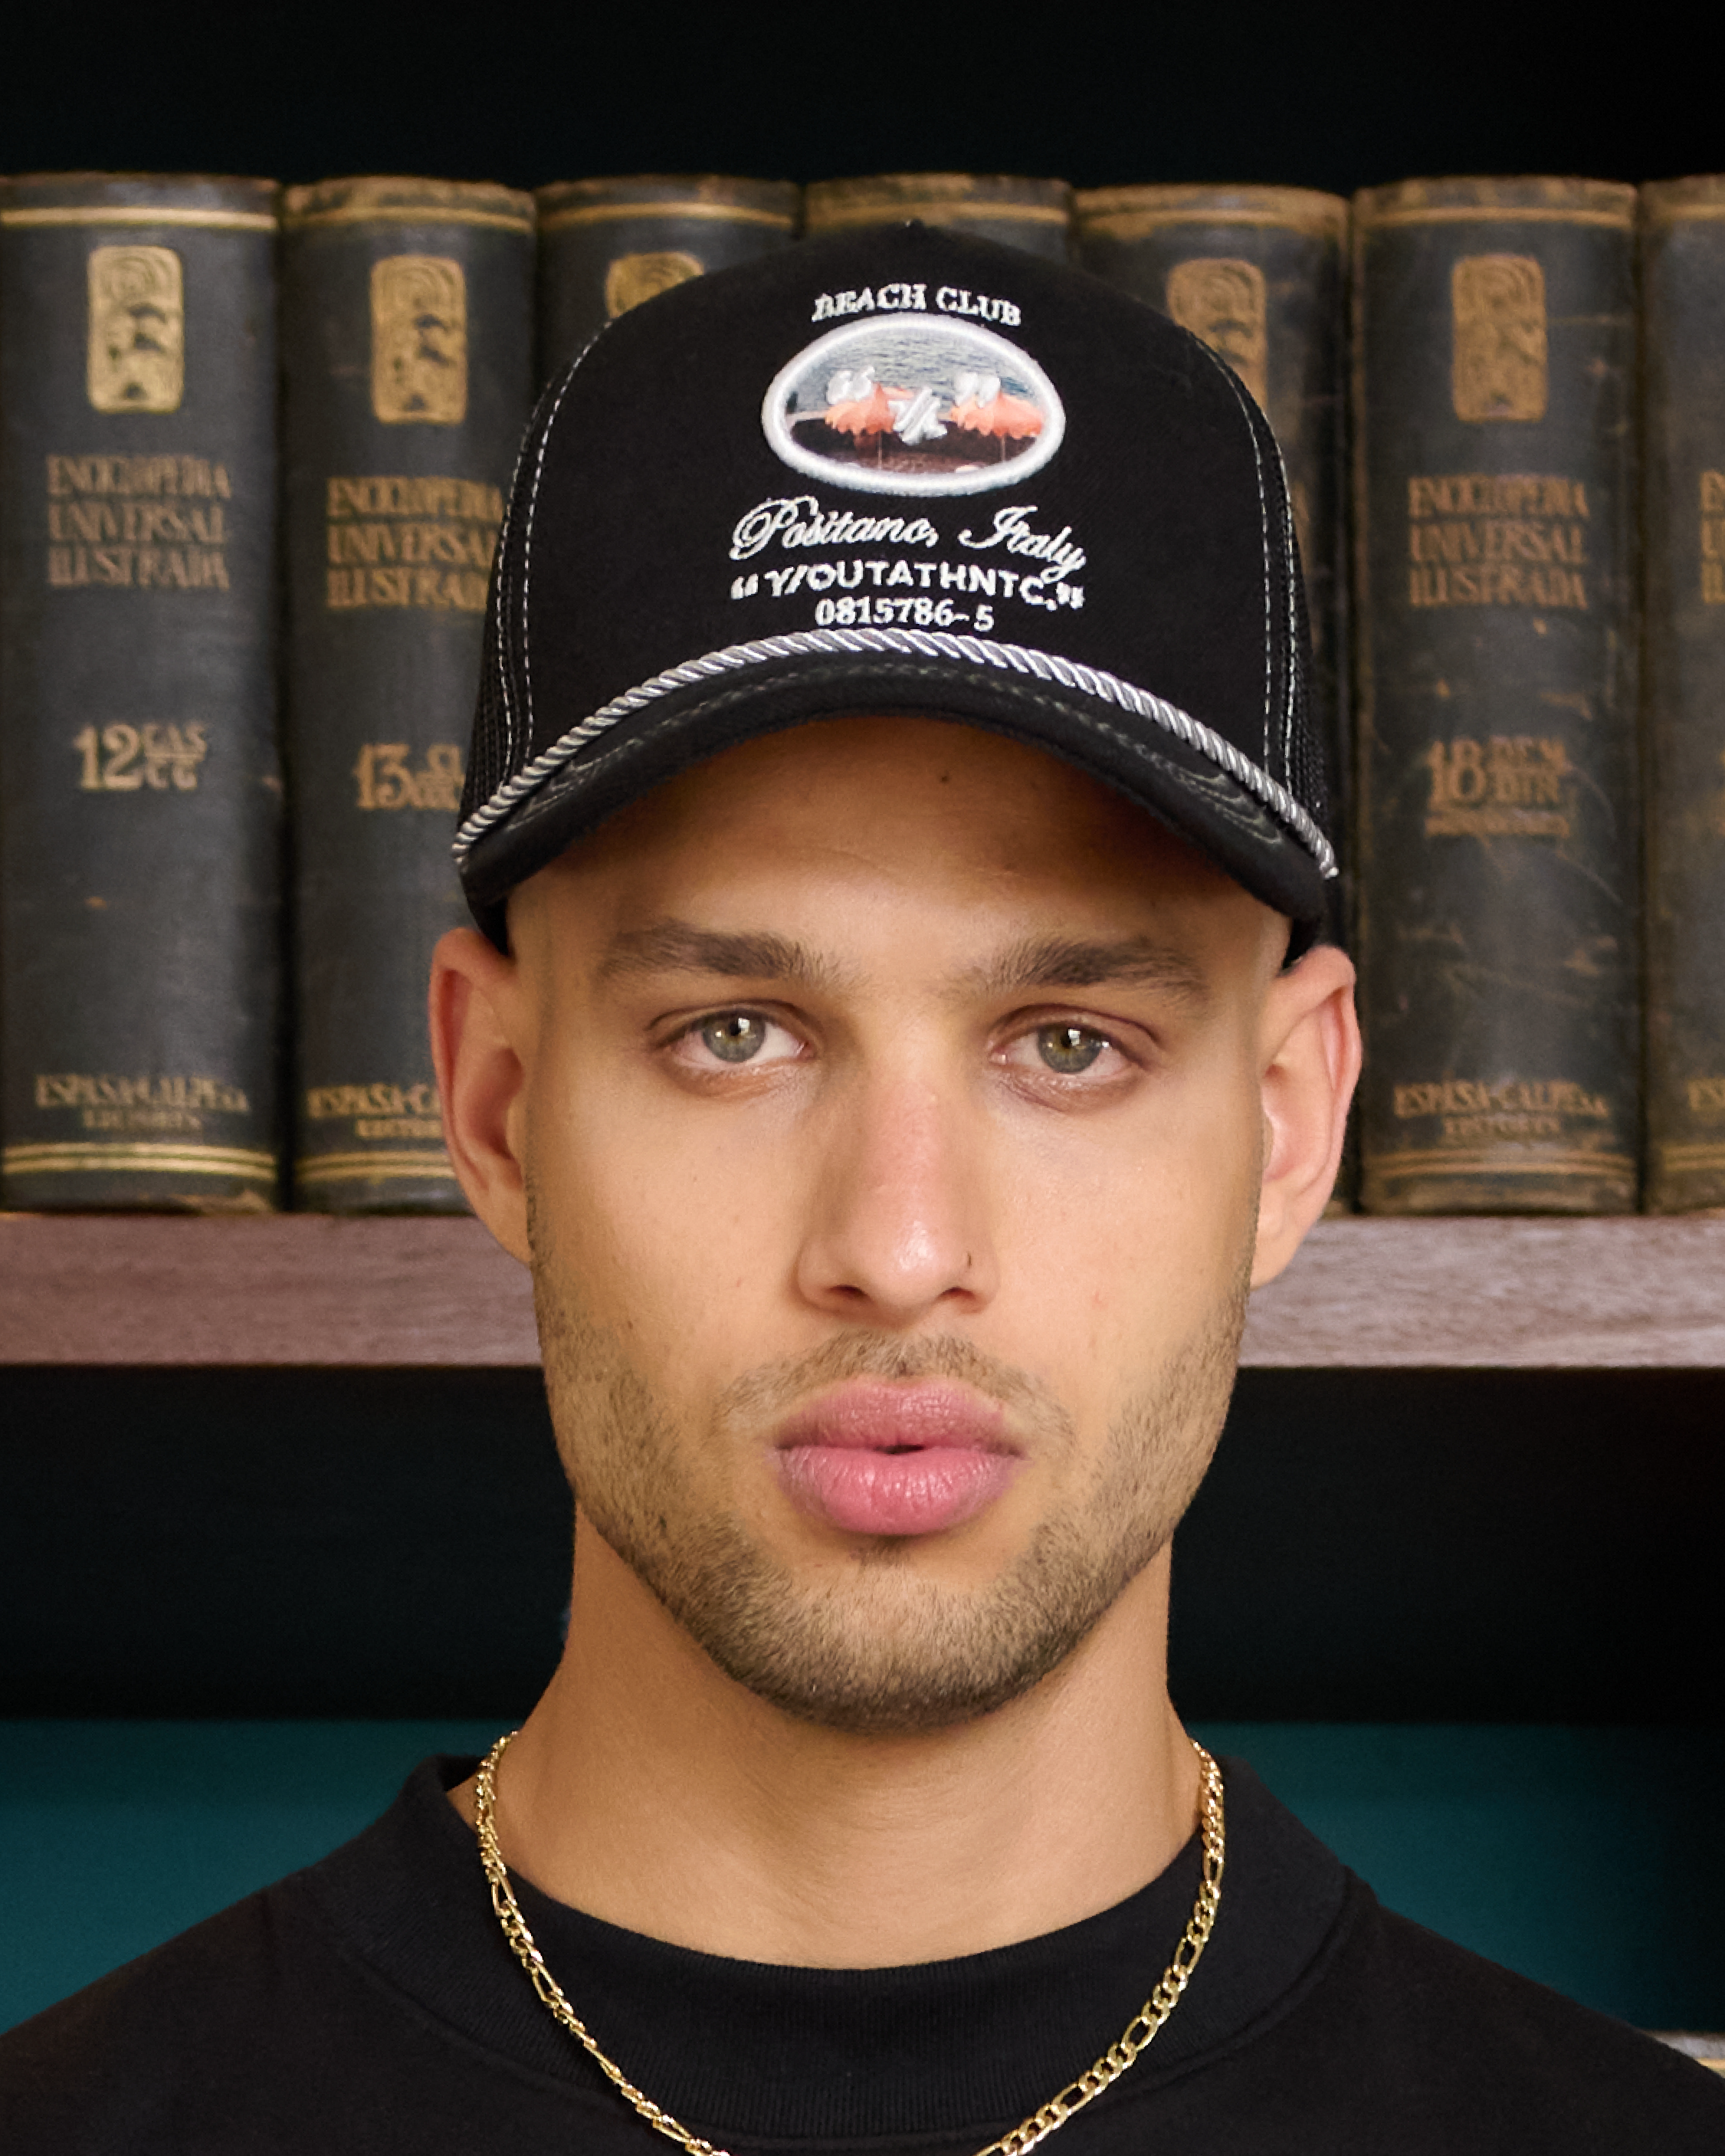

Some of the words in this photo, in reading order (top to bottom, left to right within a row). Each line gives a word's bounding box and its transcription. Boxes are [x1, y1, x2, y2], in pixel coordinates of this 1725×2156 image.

[811, 283, 927, 323] BEACH
[936, 286, 1022, 327] CLUB
[729, 494, 940, 561] Positano,
[957, 505, 1087, 584] Italy
[73, 723, 142, 791] 12
[1426, 737, 1487, 805] 18
